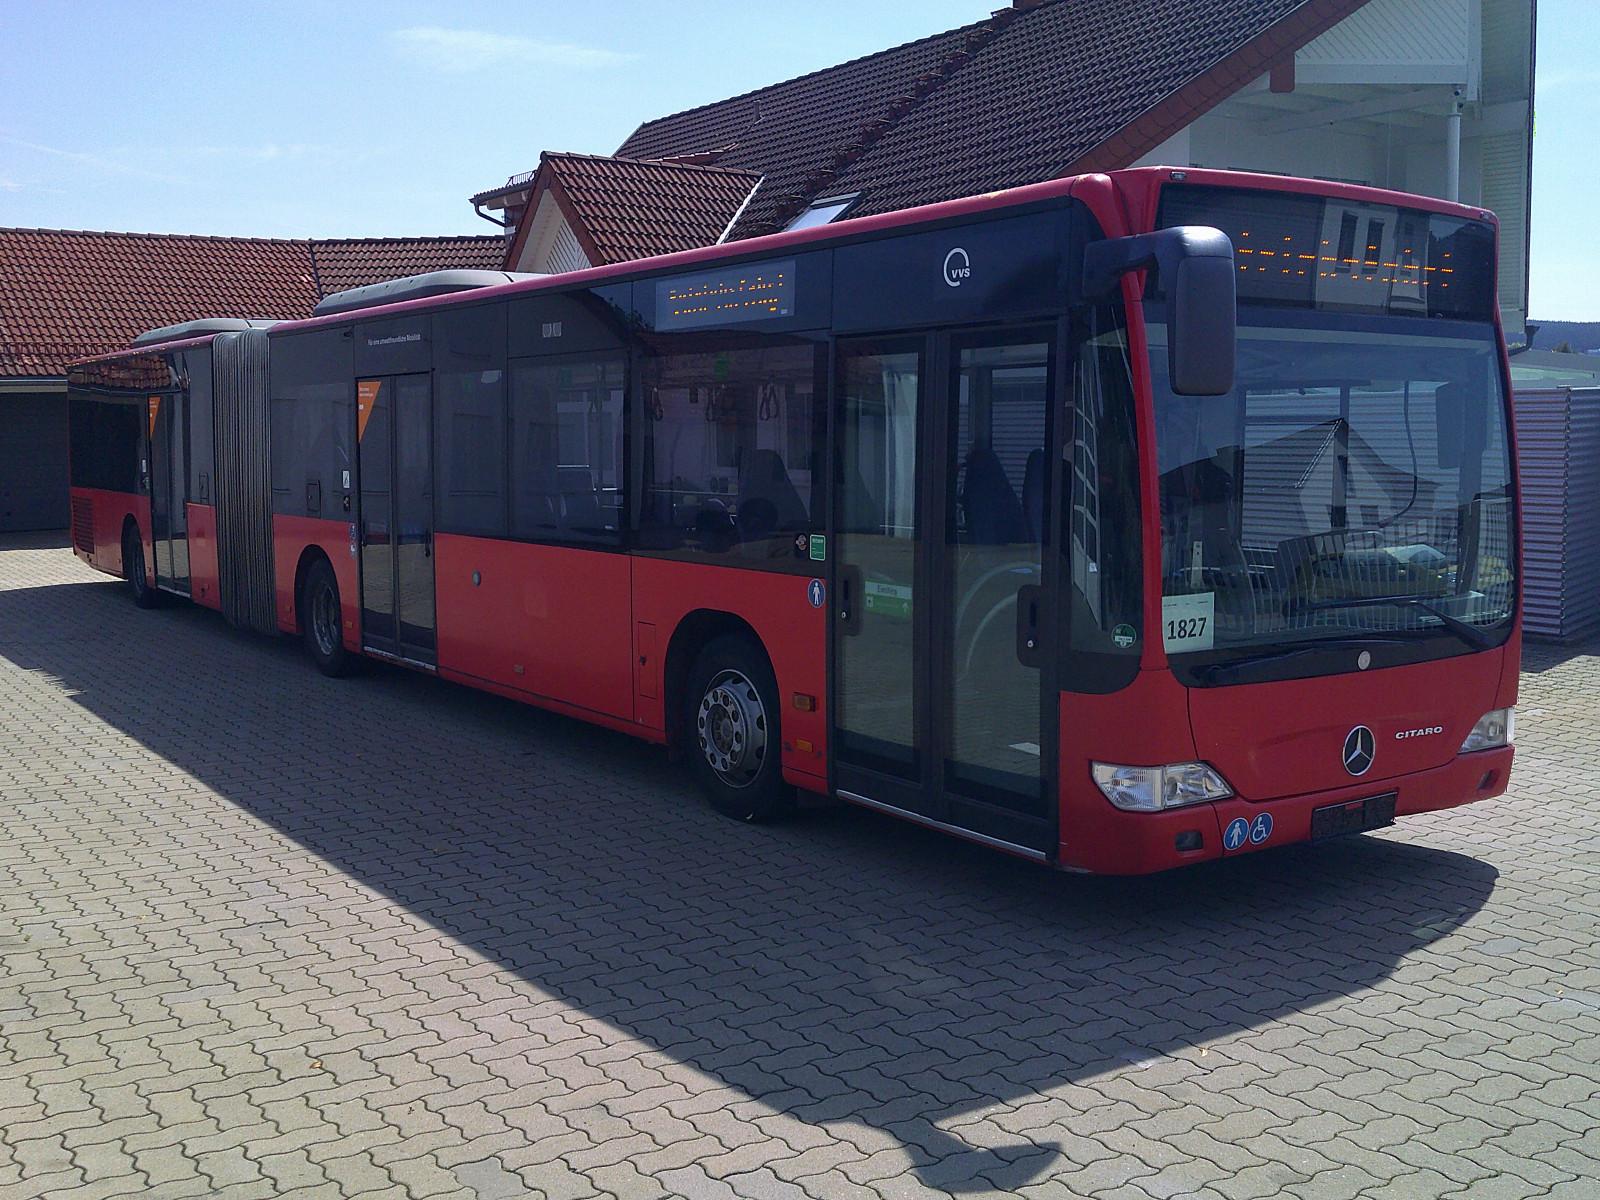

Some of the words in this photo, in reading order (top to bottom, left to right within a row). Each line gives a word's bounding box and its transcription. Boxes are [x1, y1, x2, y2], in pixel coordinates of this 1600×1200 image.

[951, 267, 970, 279] VVS
[1167, 617, 1207, 640] 1827
[1395, 726, 1443, 740] CITARO
